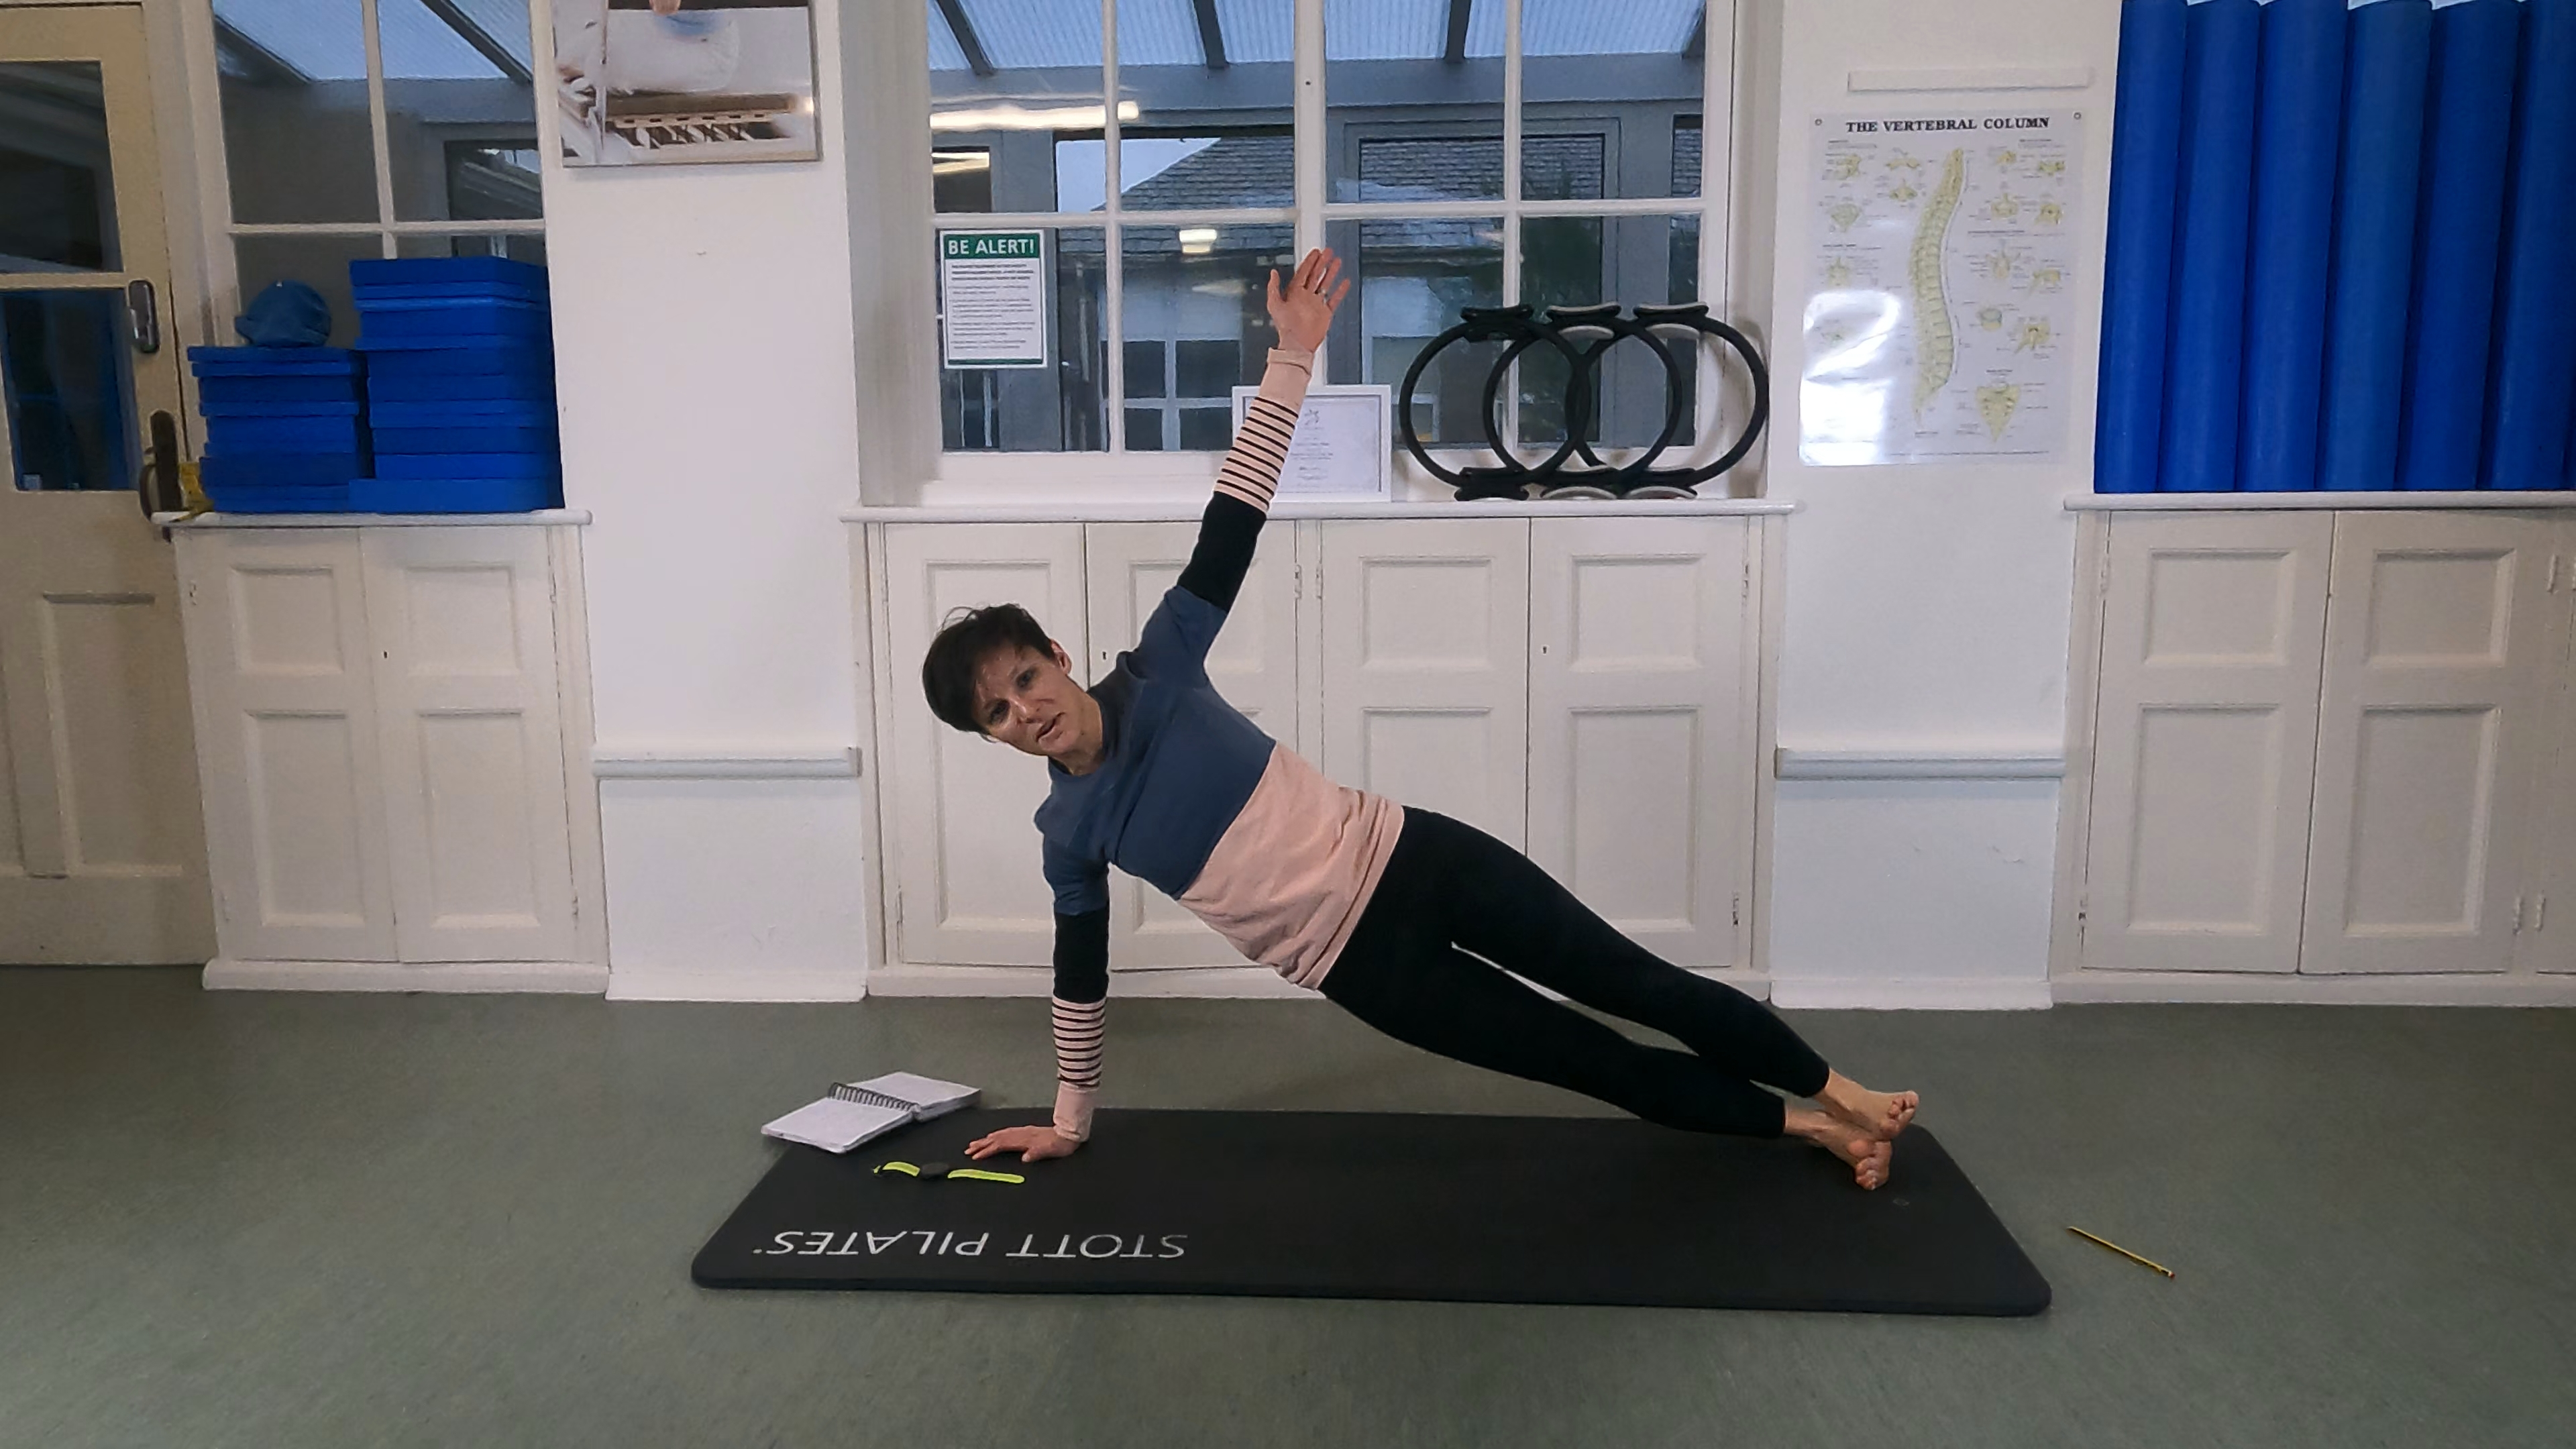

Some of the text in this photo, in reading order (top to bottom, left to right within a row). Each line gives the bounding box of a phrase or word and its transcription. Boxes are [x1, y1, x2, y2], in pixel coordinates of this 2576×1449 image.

[1845, 117, 2050, 132] THE VERTEBRAL COLUMN
[949, 239, 1034, 255] BE ALERT!
[765, 1230, 1187, 1258] STOTT PILATES
